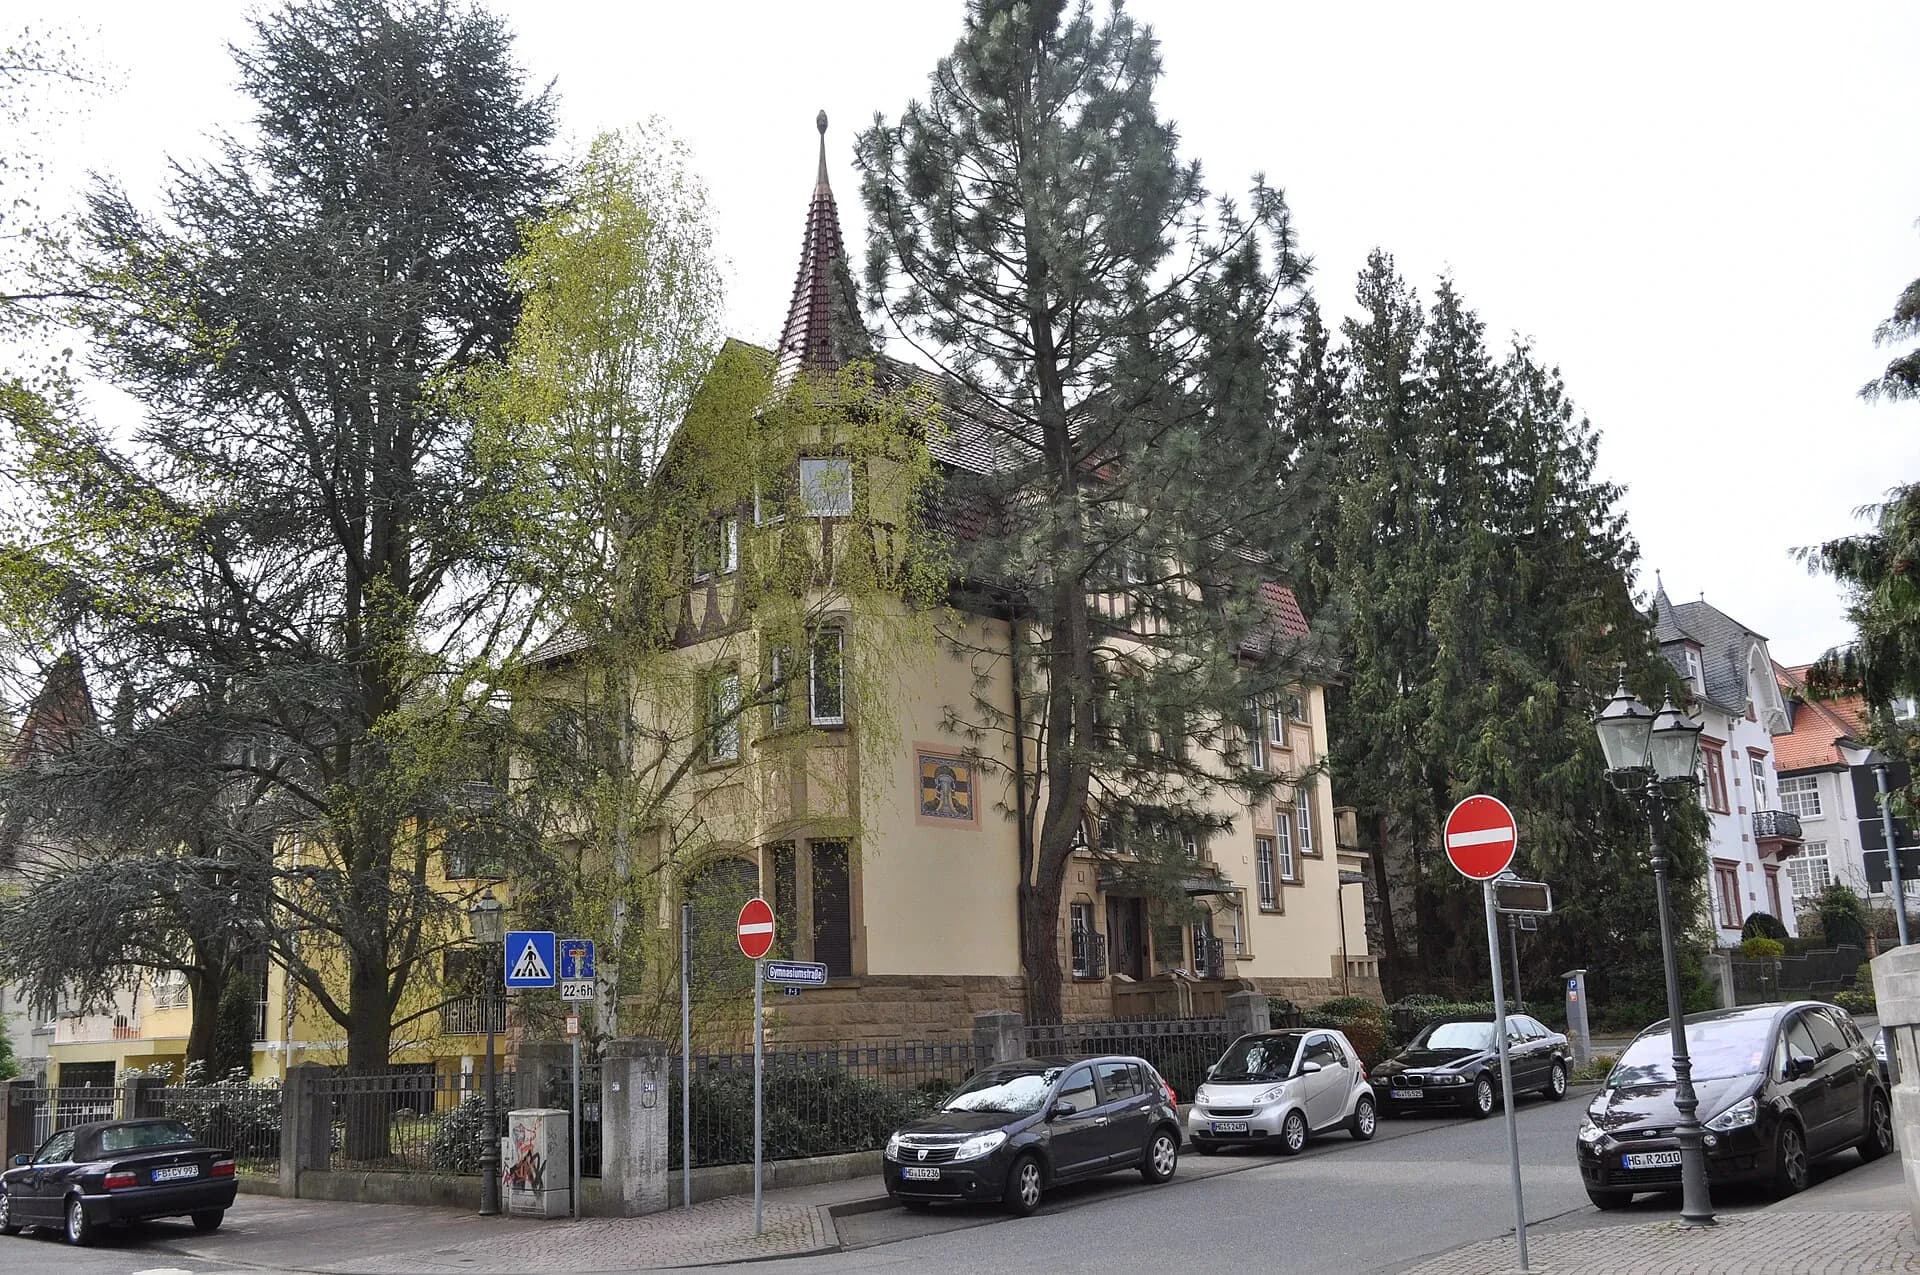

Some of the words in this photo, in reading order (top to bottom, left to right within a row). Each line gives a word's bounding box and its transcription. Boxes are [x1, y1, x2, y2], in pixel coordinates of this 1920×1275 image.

[770, 966, 822, 980] Gymnasiumstraße
[1570, 980, 1576, 989] P
[1628, 1155, 1641, 1166] HG
[1646, 1154, 1654, 1165] R
[1655, 1152, 1680, 1164] 2010
[183, 1166, 198, 1175] 993
[926, 1169, 939, 1178] 236
